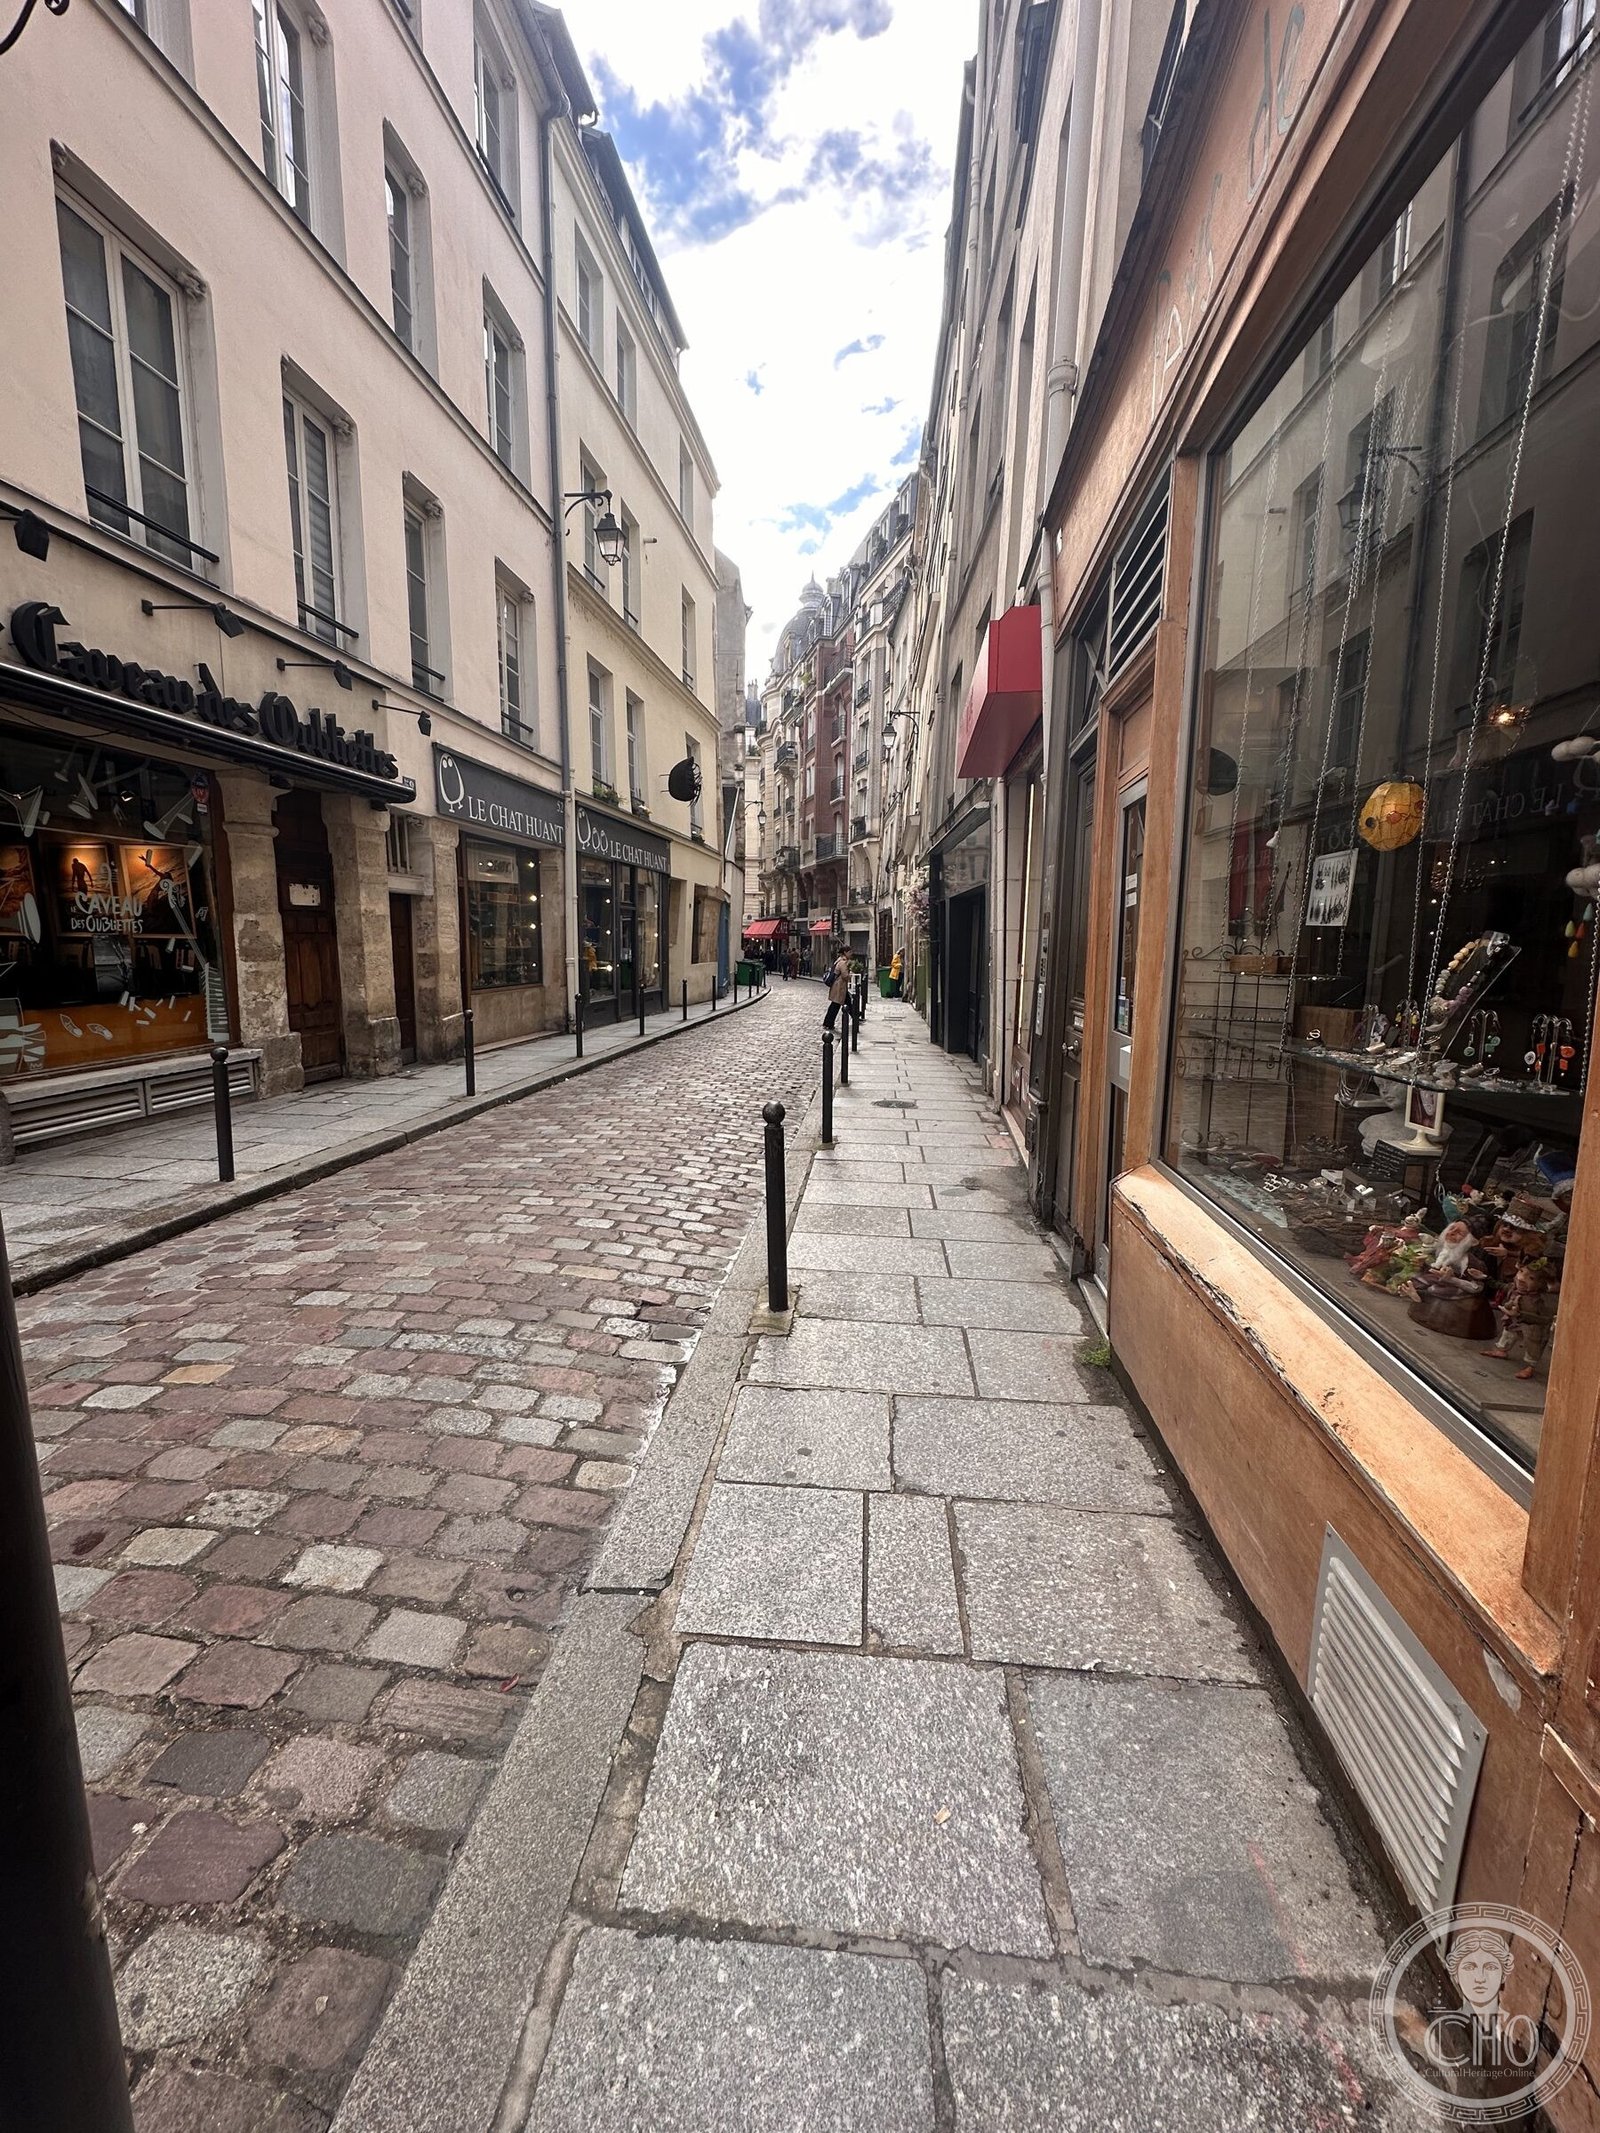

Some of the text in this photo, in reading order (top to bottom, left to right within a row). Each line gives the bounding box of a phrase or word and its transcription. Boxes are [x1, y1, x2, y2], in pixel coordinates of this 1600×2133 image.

[11, 601, 399, 779] Caveau des Oubliettes
[467, 796, 563, 844] LE CHAT HUANT
[610, 840, 667, 872] LE CHAT HUANT
[75, 891, 143, 917] CAVEAU
[71, 918, 85, 930] DES
